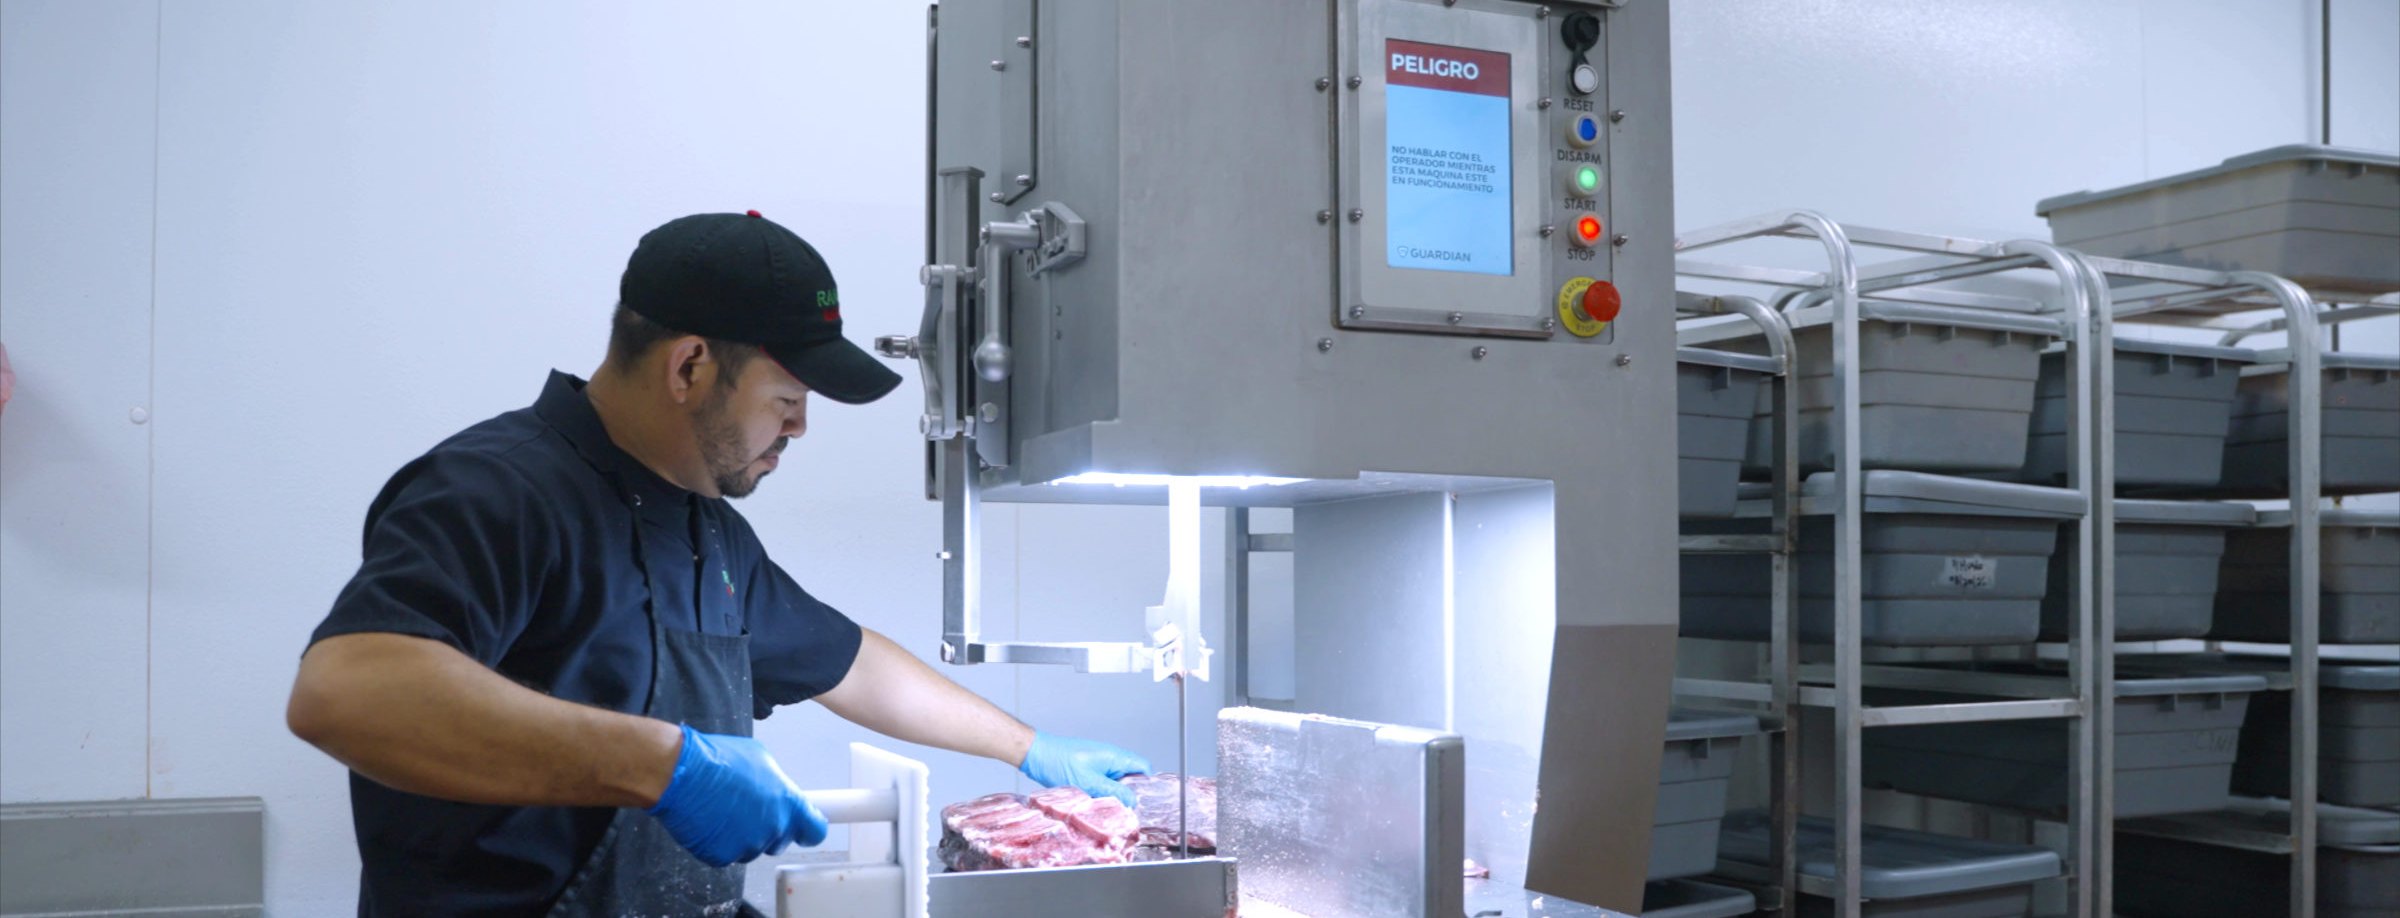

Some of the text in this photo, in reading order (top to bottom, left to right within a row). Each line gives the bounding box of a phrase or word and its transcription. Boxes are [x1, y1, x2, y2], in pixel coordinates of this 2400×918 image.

[1392, 53, 1479, 80] PELIGRO
[1563, 98, 1594, 112] RESET
[1392, 146, 1481, 162] NO HABLAR CON EL
[1557, 149, 1602, 164] DISARM
[1392, 155, 1496, 173] OPERADOR MIENTRAS
[1392, 166, 1488, 182] ESTA MAQUINA ESTE
[1392, 176, 1494, 193] EN FUNCIONAMIENTO
[1564, 198, 1597, 211] START
[1410, 248, 1471, 262] GUARDIAN
[1567, 248, 1595, 261] STOP
